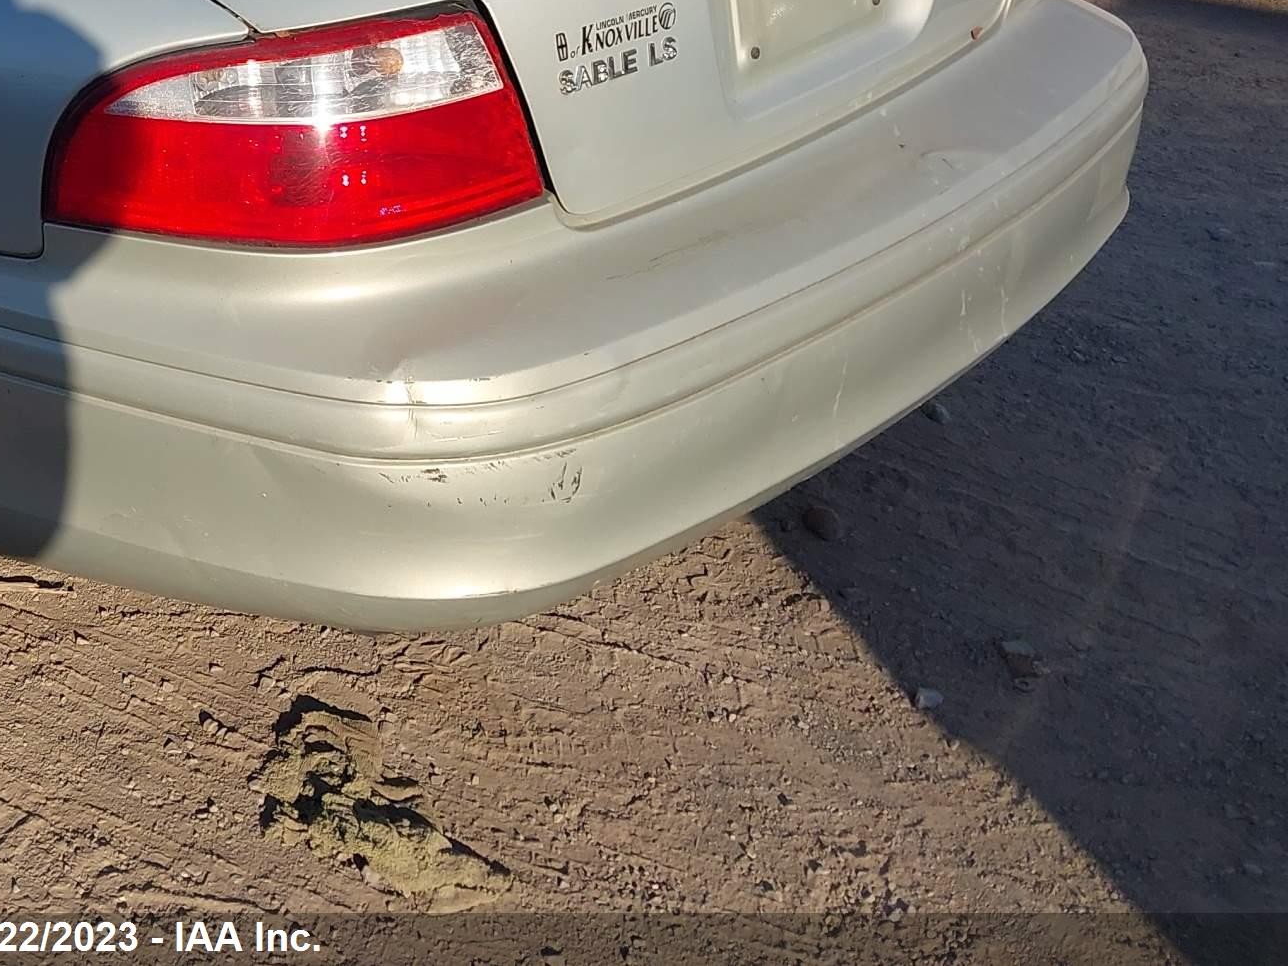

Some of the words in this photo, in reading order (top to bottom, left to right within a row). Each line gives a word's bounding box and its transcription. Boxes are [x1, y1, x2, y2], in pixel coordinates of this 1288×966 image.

[581, 15, 659, 56] KNOXVILLE
[595, 15, 625, 31] LINCOLN
[558, 48, 639, 96] SABLE
[647, 36, 678, 67] LS
